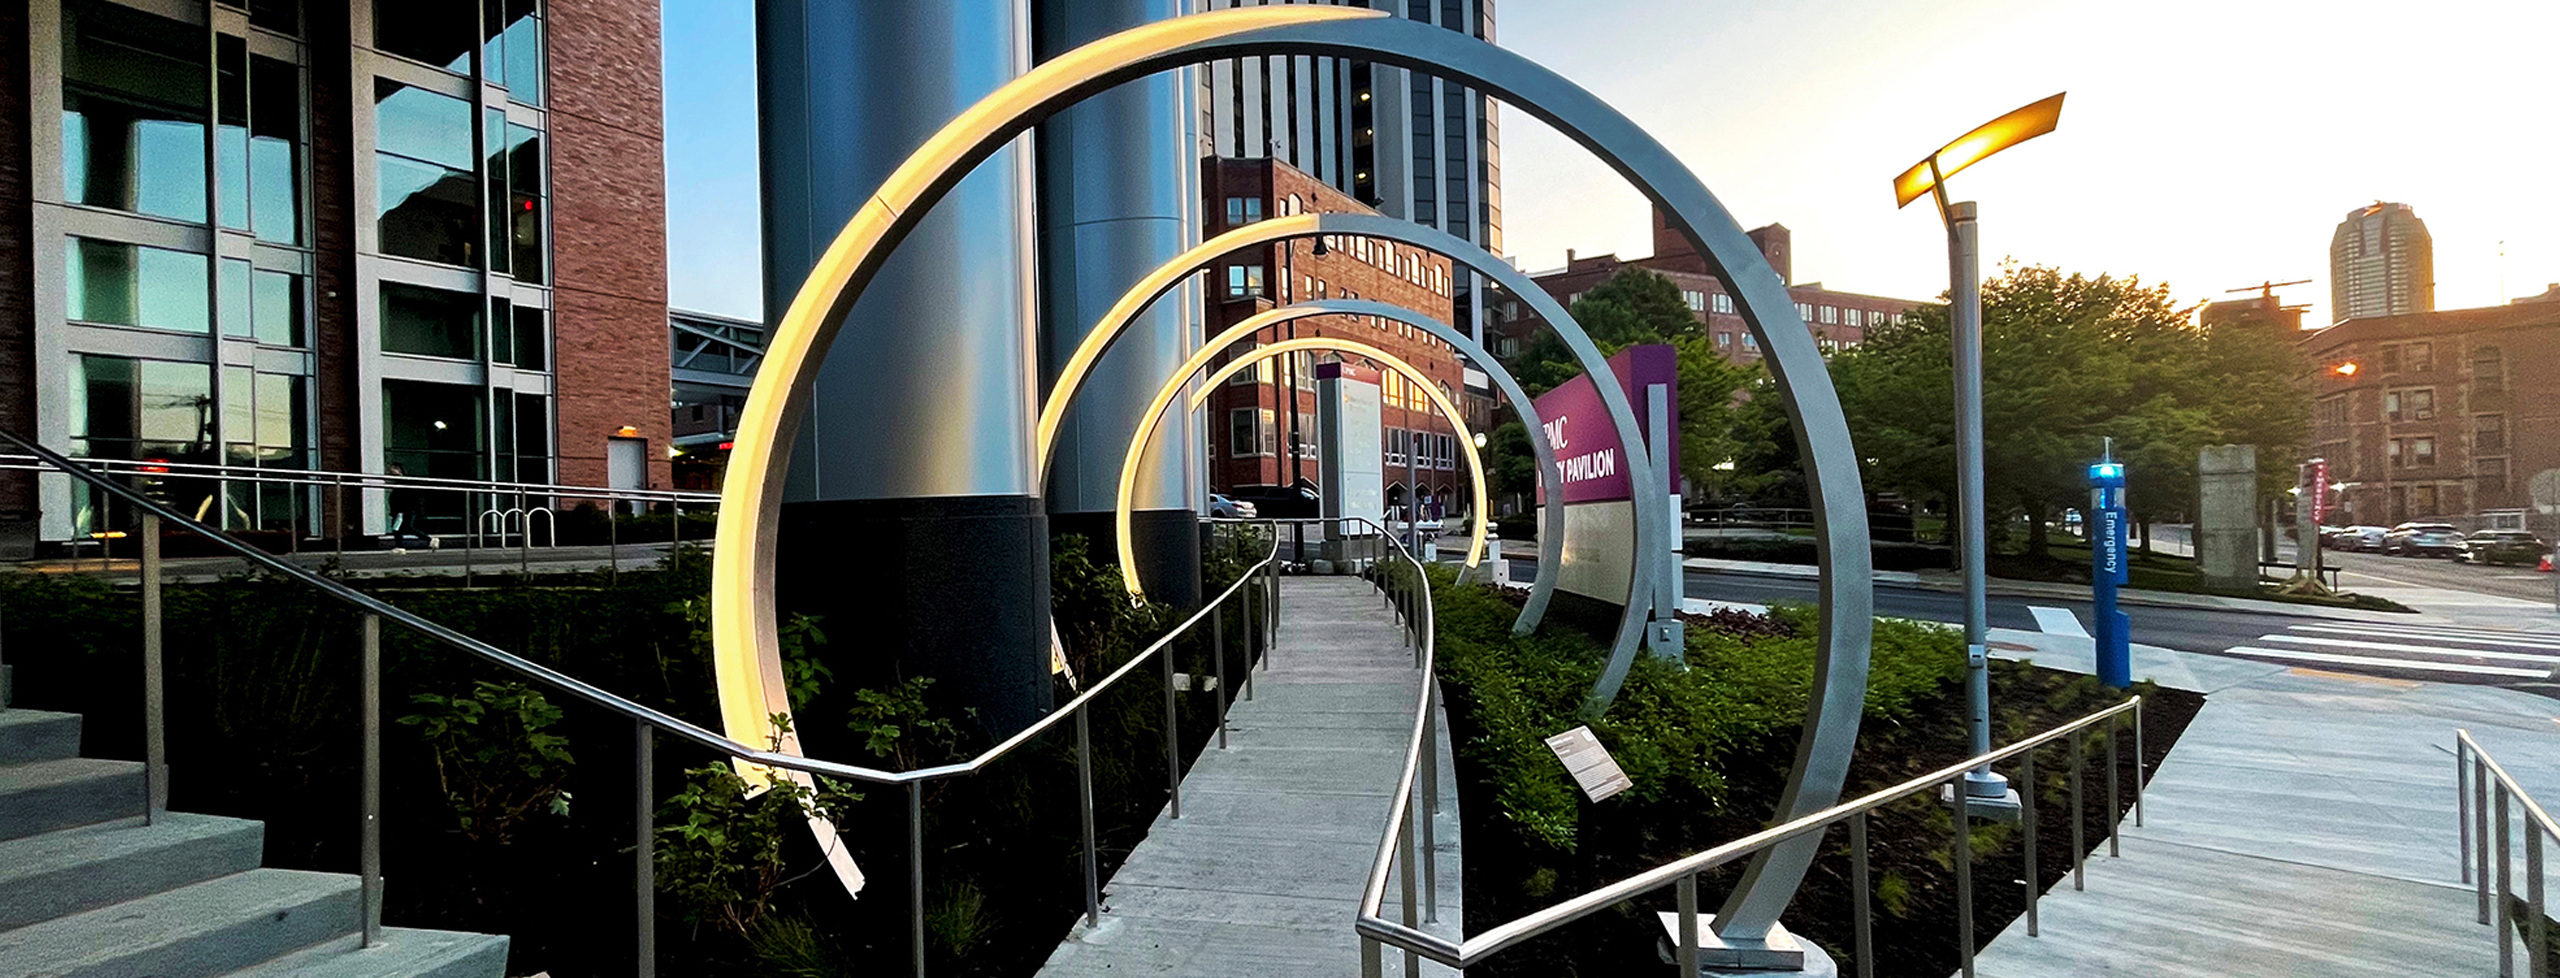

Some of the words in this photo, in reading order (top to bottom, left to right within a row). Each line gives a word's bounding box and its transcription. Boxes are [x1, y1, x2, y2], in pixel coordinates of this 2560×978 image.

[1543, 416, 1568, 450] PMC
[1567, 448, 1614, 483] PAVILION
[2104, 511, 2117, 573] Emergency
